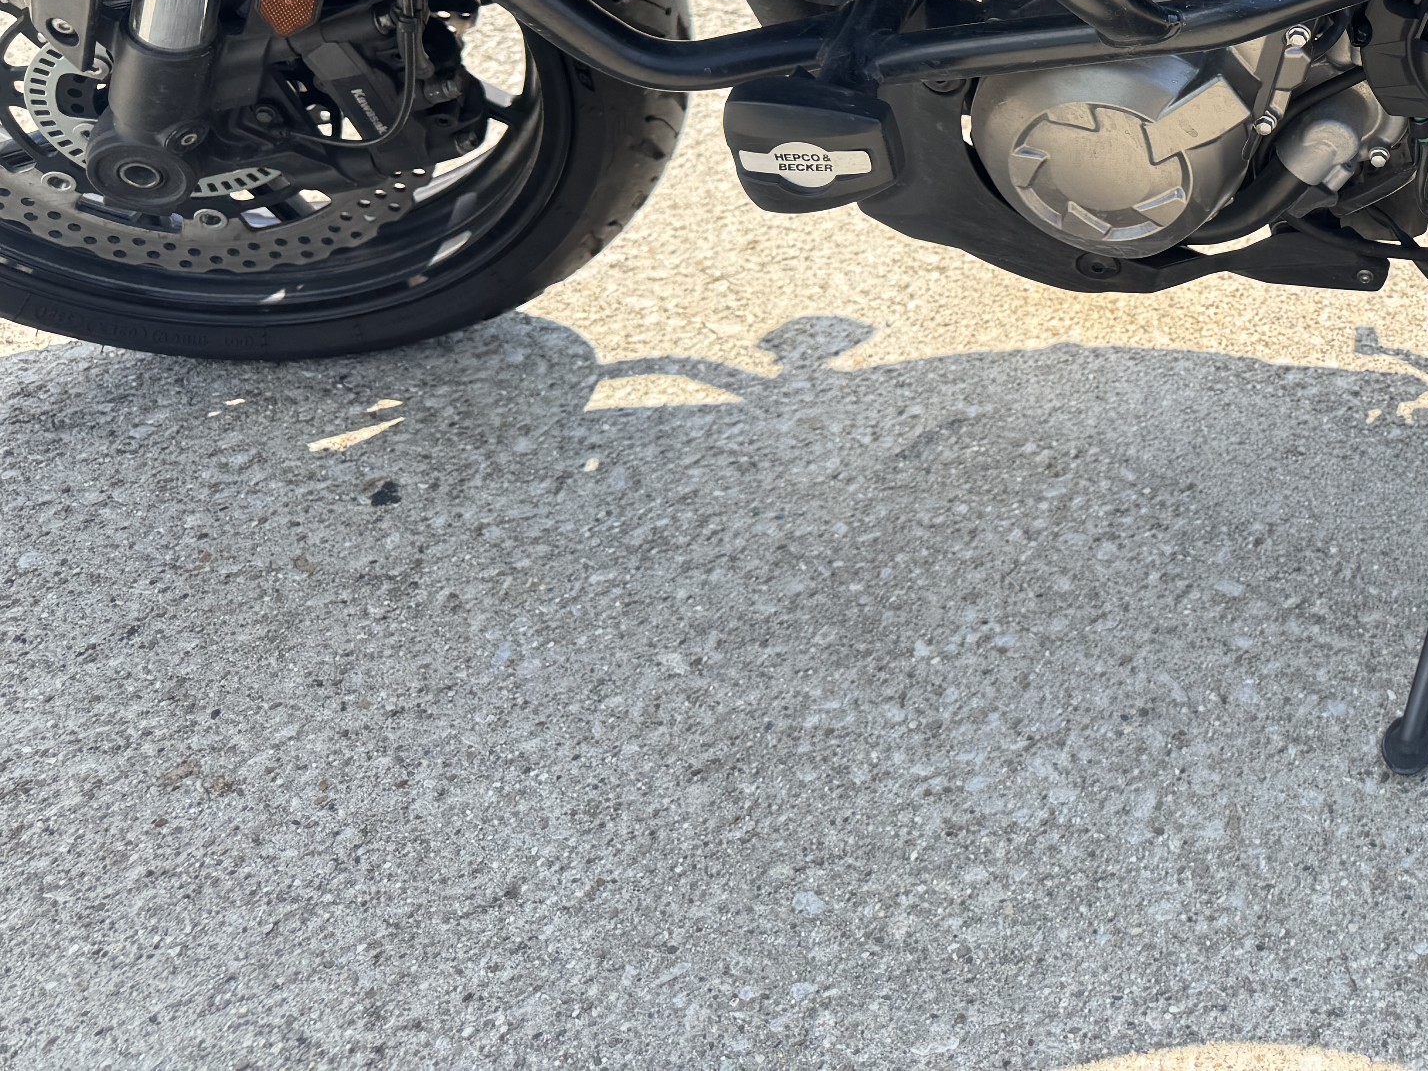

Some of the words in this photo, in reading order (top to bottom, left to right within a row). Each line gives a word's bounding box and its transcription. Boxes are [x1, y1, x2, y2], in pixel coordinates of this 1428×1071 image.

[351, 88, 388, 135] Kawasak
[774, 153, 820, 162] HEPCO
[822, 153, 832, 162] &
[778, 163, 833, 172] BECKER
